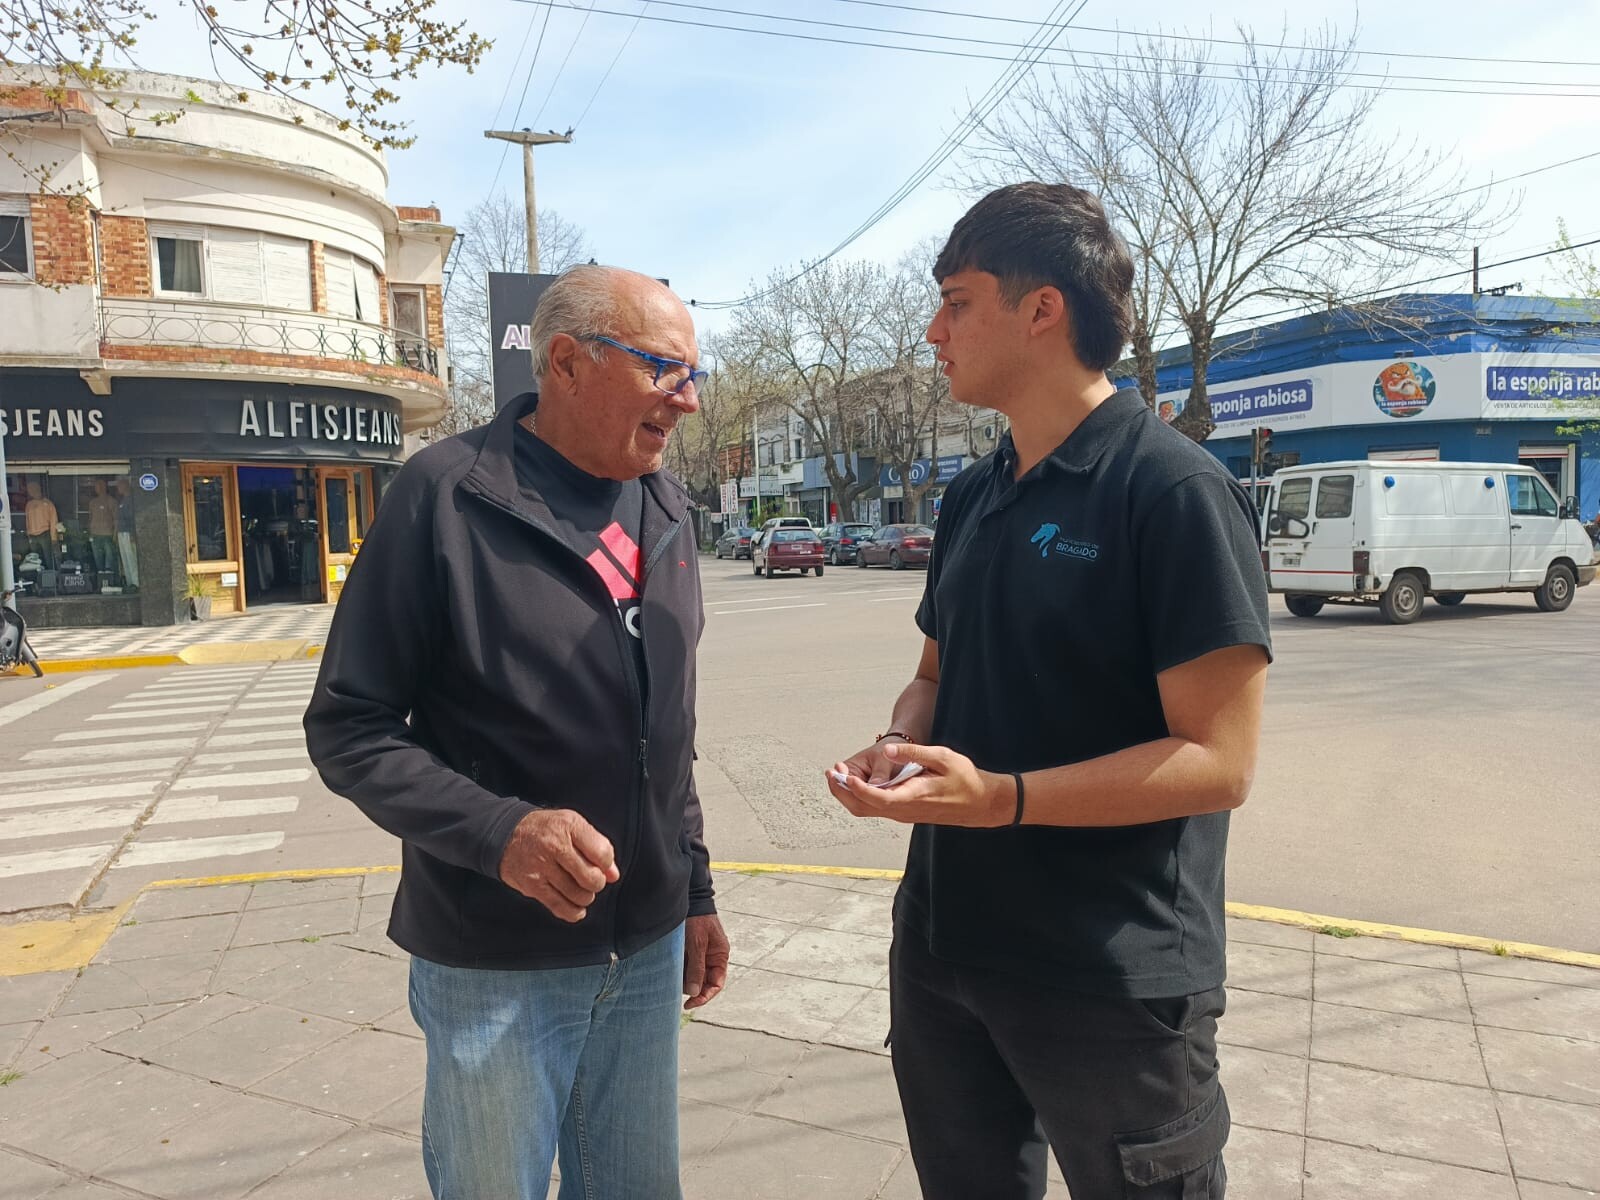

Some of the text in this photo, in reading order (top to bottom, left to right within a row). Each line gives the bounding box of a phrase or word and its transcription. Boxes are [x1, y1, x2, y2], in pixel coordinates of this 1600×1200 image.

[1492, 371, 1506, 391] la
[1510, 372, 1573, 396] esponja
[1254, 388, 1307, 408] rabiosa
[240, 400, 400, 445] ALFISJEANS
